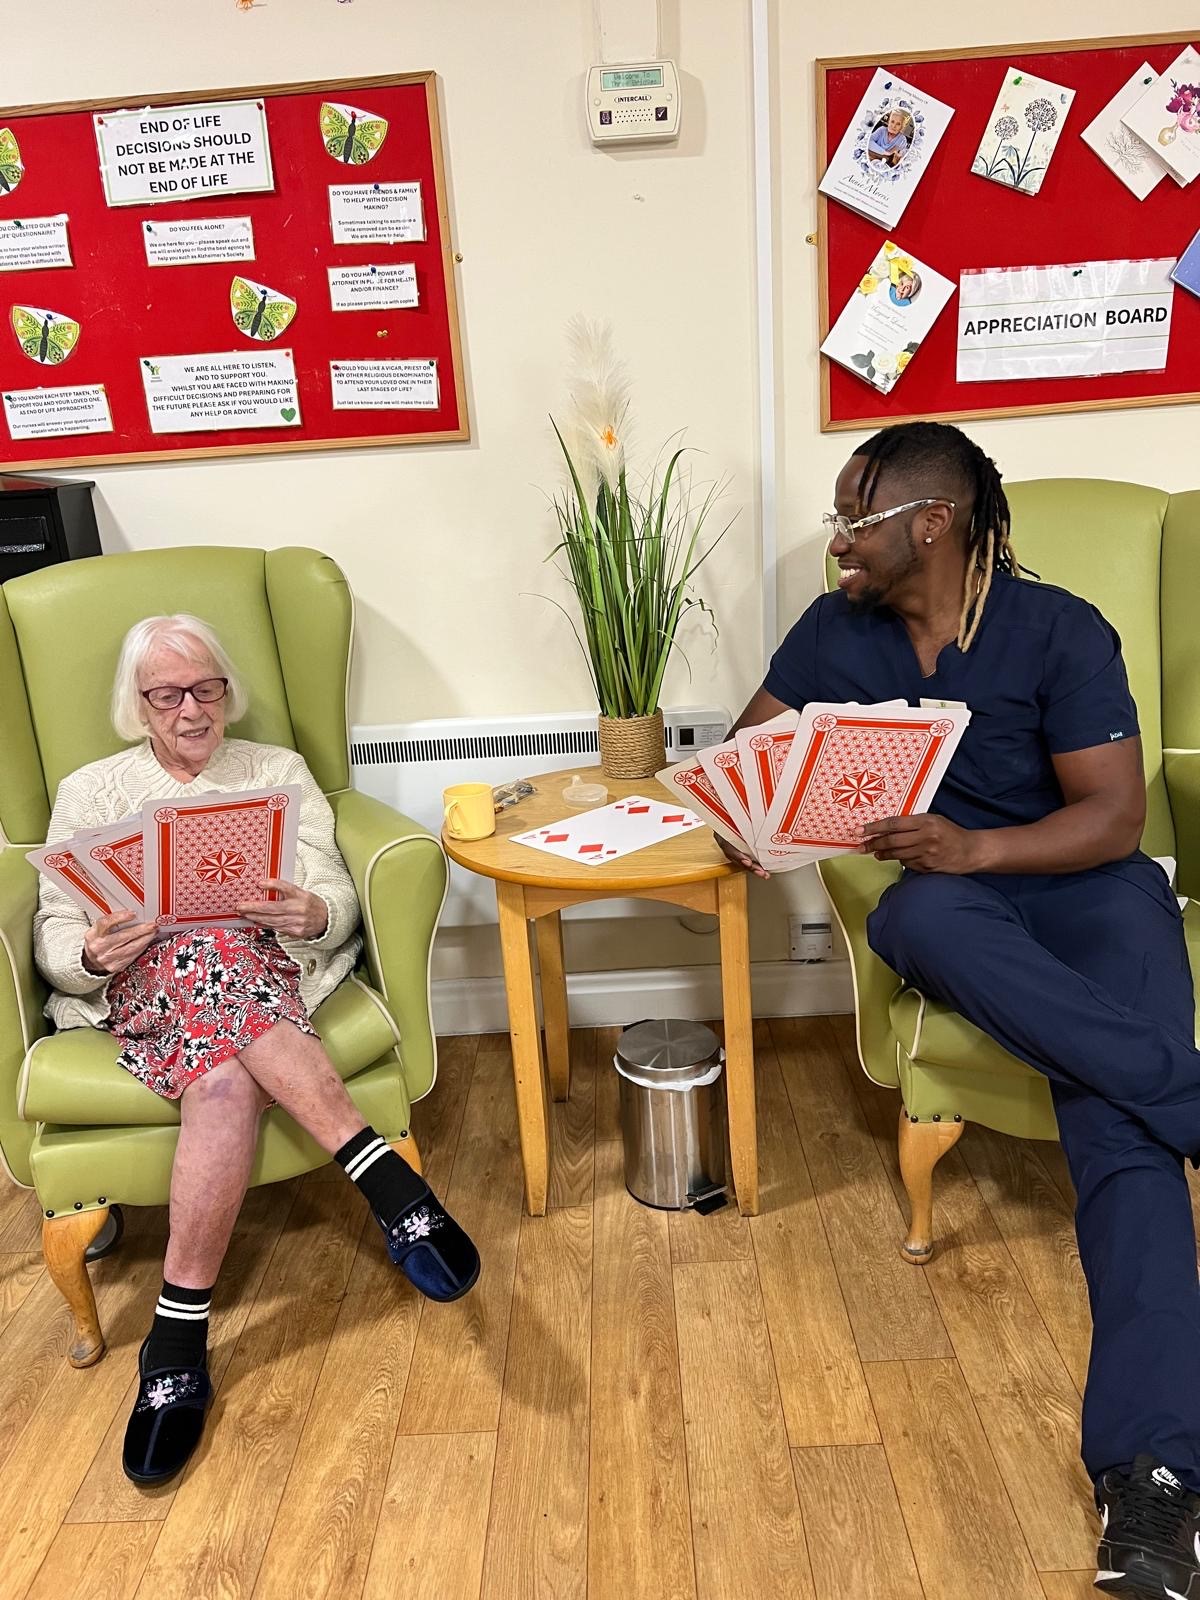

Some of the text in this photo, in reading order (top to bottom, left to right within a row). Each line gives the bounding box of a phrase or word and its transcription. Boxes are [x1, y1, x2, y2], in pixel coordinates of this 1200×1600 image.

[140, 115, 221, 133] END OF LIFE
[116, 133, 251, 156] DECISIONS SHOULD
[118, 152, 255, 176] NOT BE MADE AT THE
[150, 174, 228, 192] END OF LIFE
[12, 230, 55, 238] QUESTIONNAIRE?
[963, 306, 1168, 336] APPRECIATION BOARD
[239, 389, 275, 397] PREPARING
[1159, 1466, 1181, 1485] NIKE
